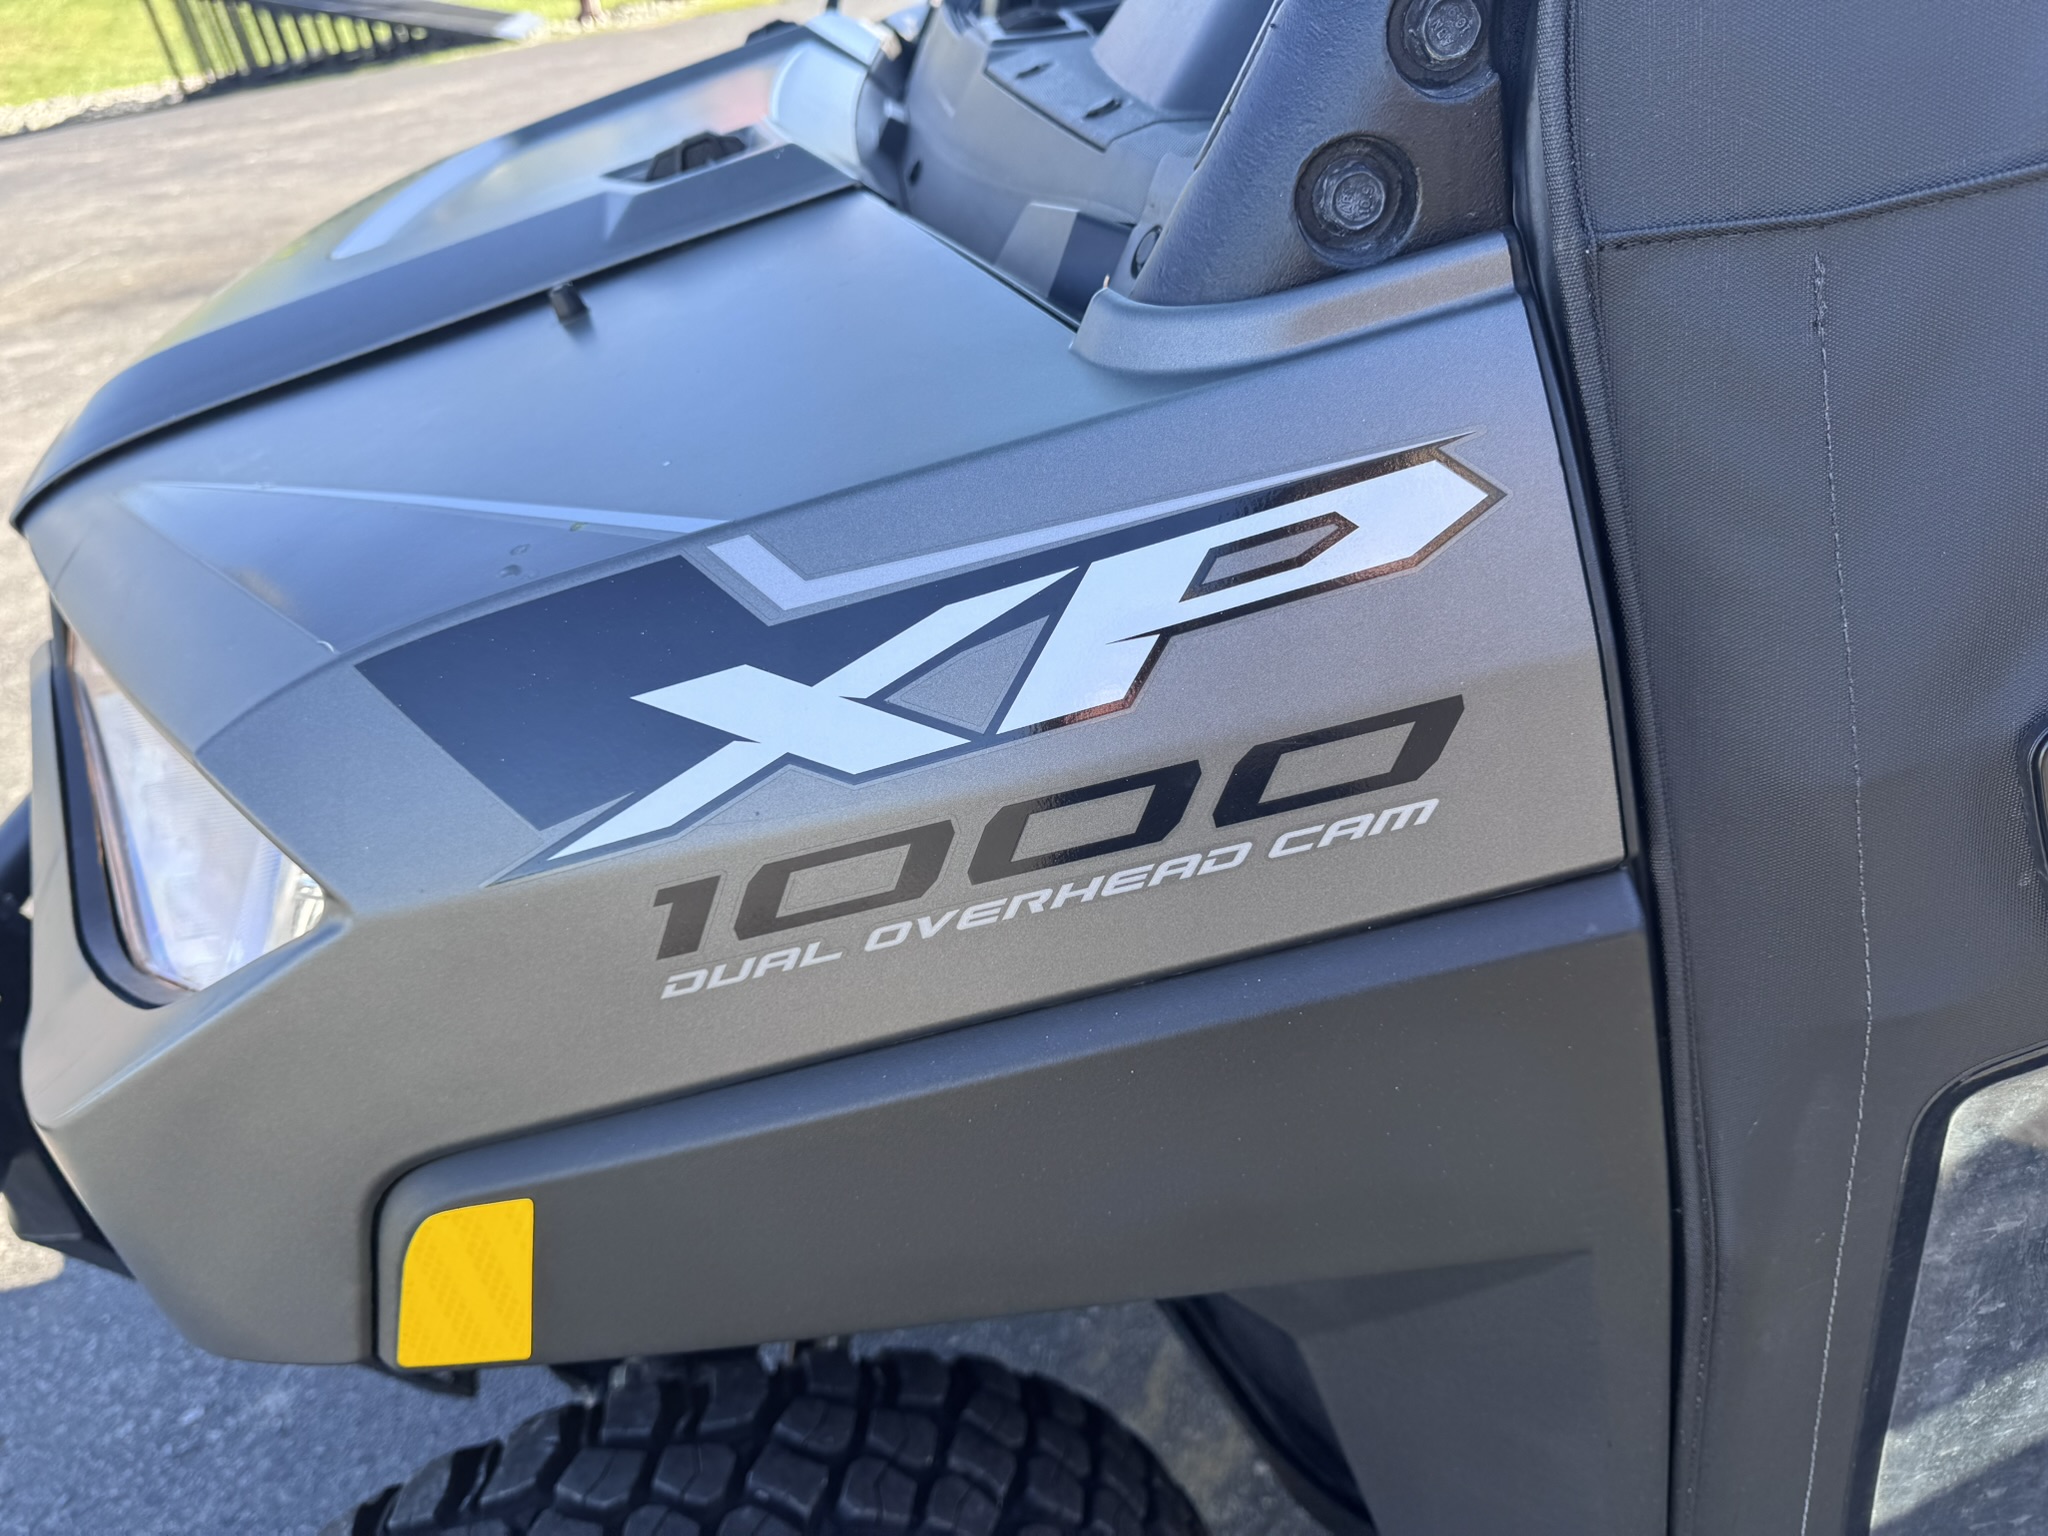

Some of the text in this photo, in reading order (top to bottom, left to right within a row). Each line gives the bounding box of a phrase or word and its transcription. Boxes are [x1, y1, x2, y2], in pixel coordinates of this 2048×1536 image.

[548, 456, 1494, 861] XP
[653, 694, 1464, 960] 1000
[661, 798, 1439, 999] DUAL OVERHEAD CAM
